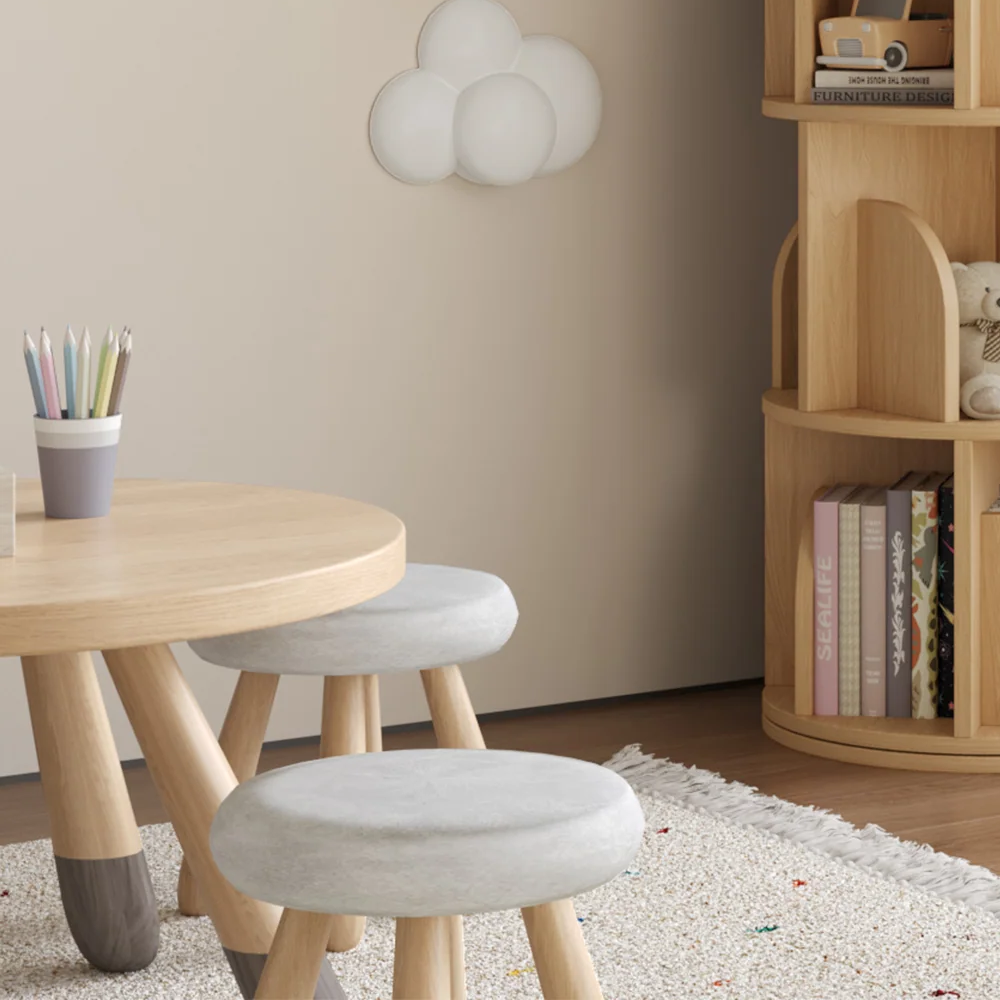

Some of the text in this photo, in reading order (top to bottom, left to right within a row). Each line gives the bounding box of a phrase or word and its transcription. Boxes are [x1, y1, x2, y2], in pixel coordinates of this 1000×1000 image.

[848, 76, 930, 85] BRINGING THE HOUSE HOME
[813, 91, 901, 103] FURNITURE
[817, 555, 833, 662] SEALIFE
